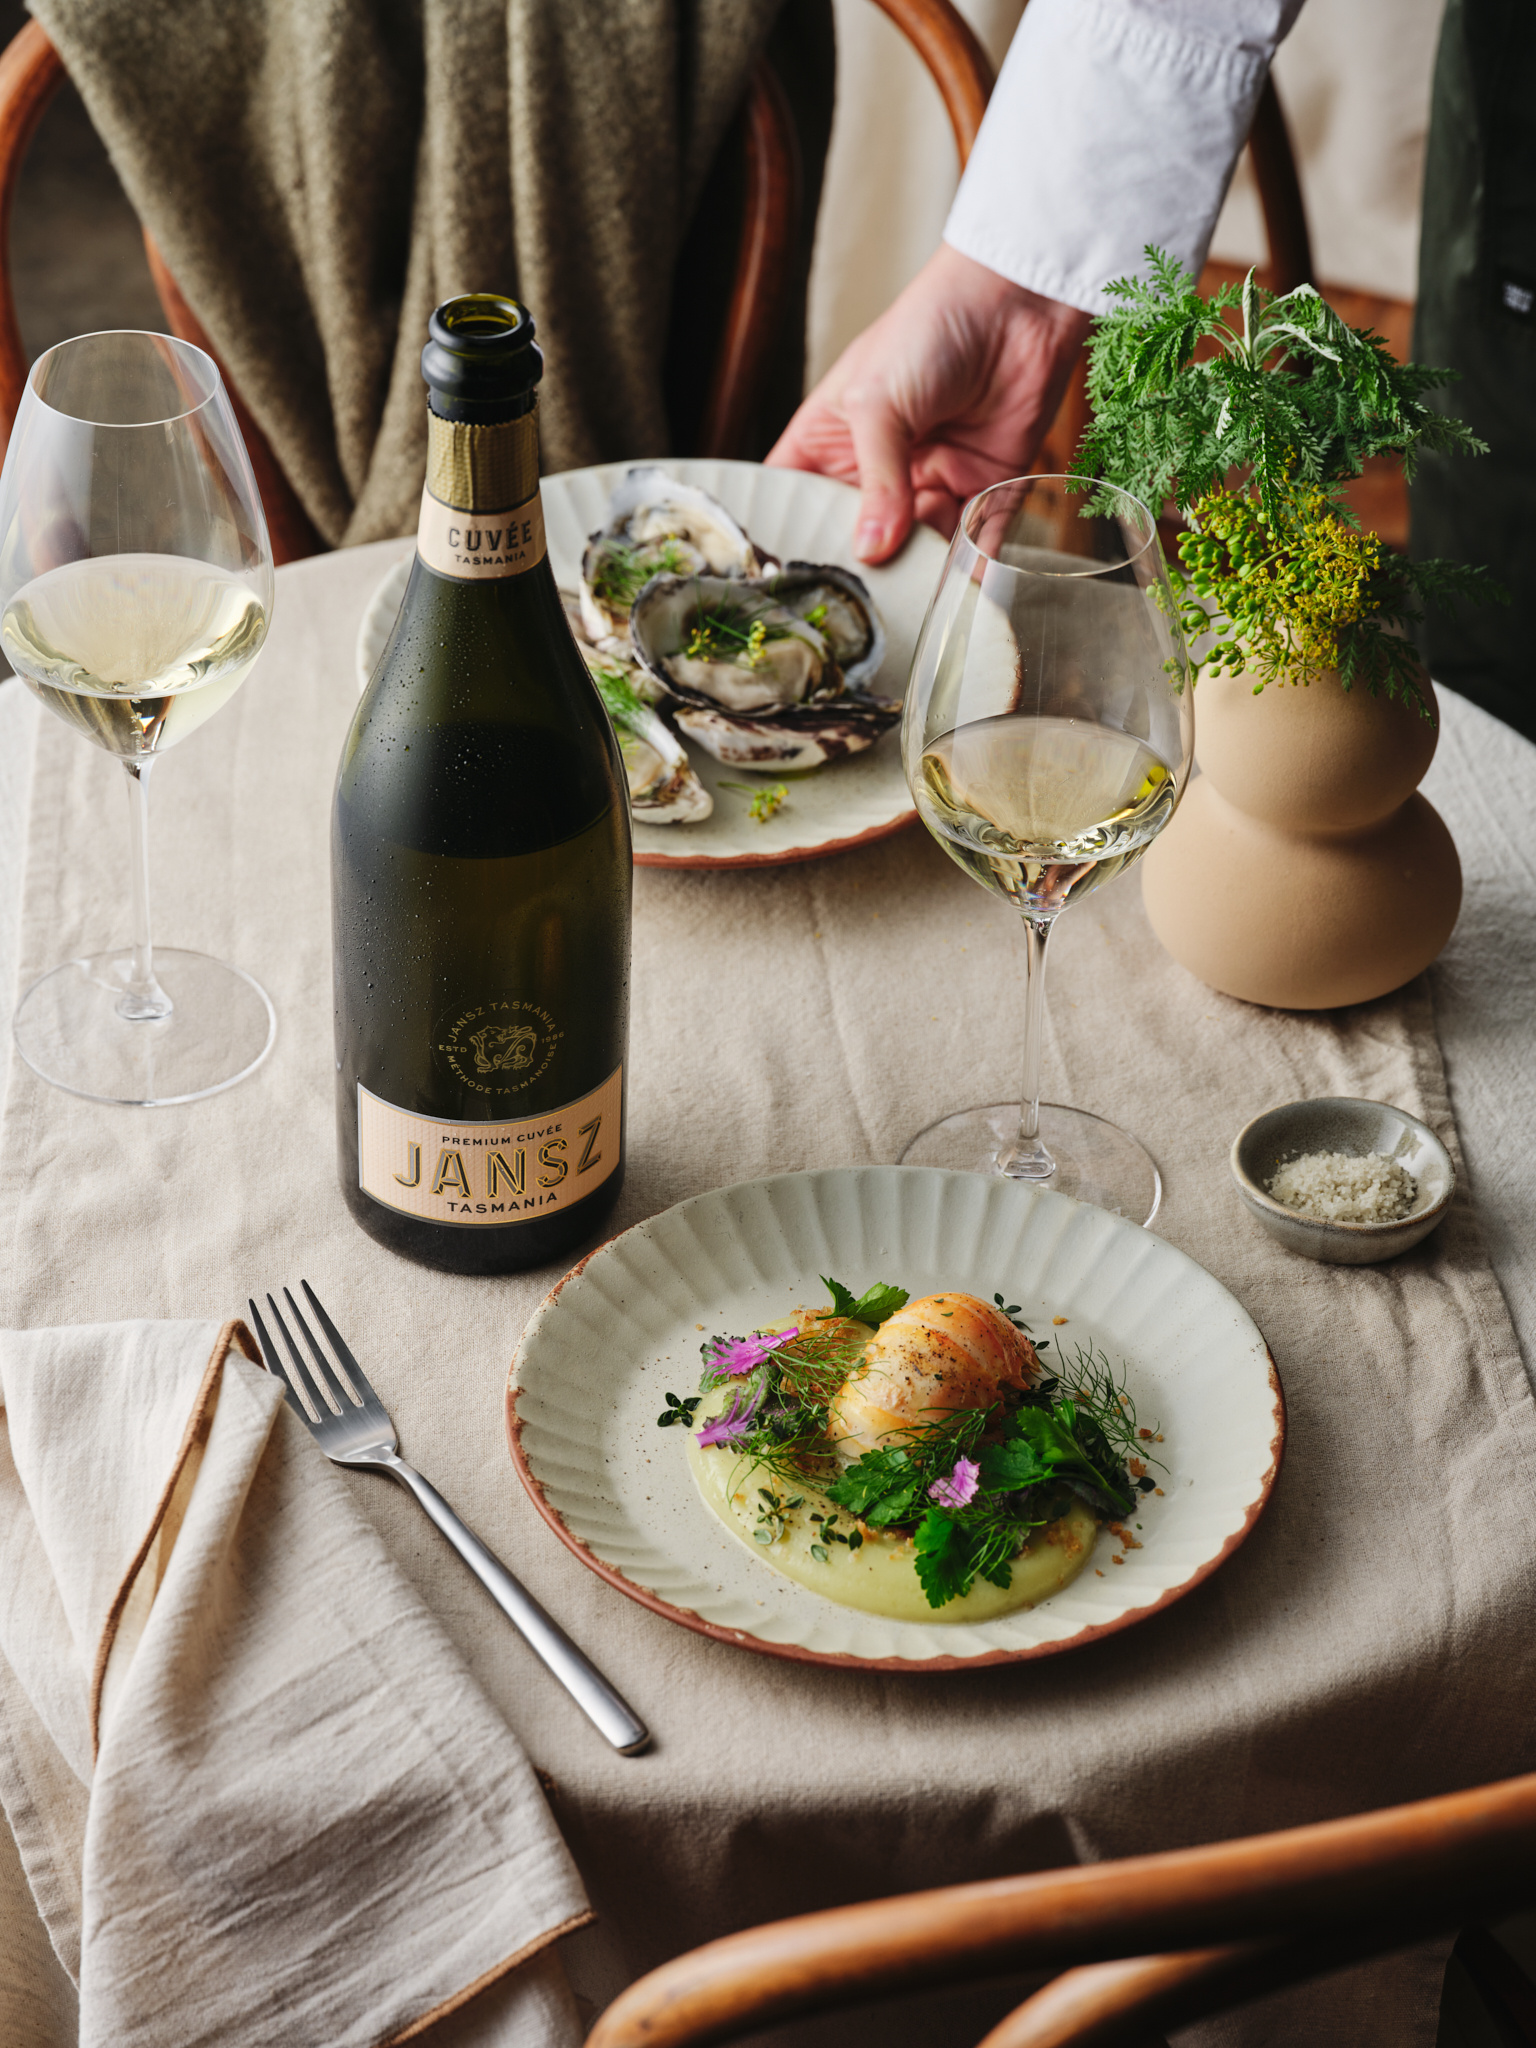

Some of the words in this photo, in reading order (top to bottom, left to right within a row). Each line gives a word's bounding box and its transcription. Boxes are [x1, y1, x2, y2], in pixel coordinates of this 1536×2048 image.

[448, 520, 532, 551] CUVÉE
[455, 551, 526, 565] TASMANIA
[447, 1006, 486, 1042] JANSZ
[489, 1000, 556, 1032] TASMANIA
[438, 1044, 467, 1053] ESTD
[541, 1031, 565, 1043] 1986
[447, 1055, 492, 1094] MÉTHODE
[496, 1043, 557, 1095] TASMANOISE
[442, 1136, 511, 1146] PREMIUM
[516, 1123, 562, 1142] CUVÉE
[392, 1114, 602, 1199] JANSZ
[447, 1192, 558, 1214] TASMANIA
